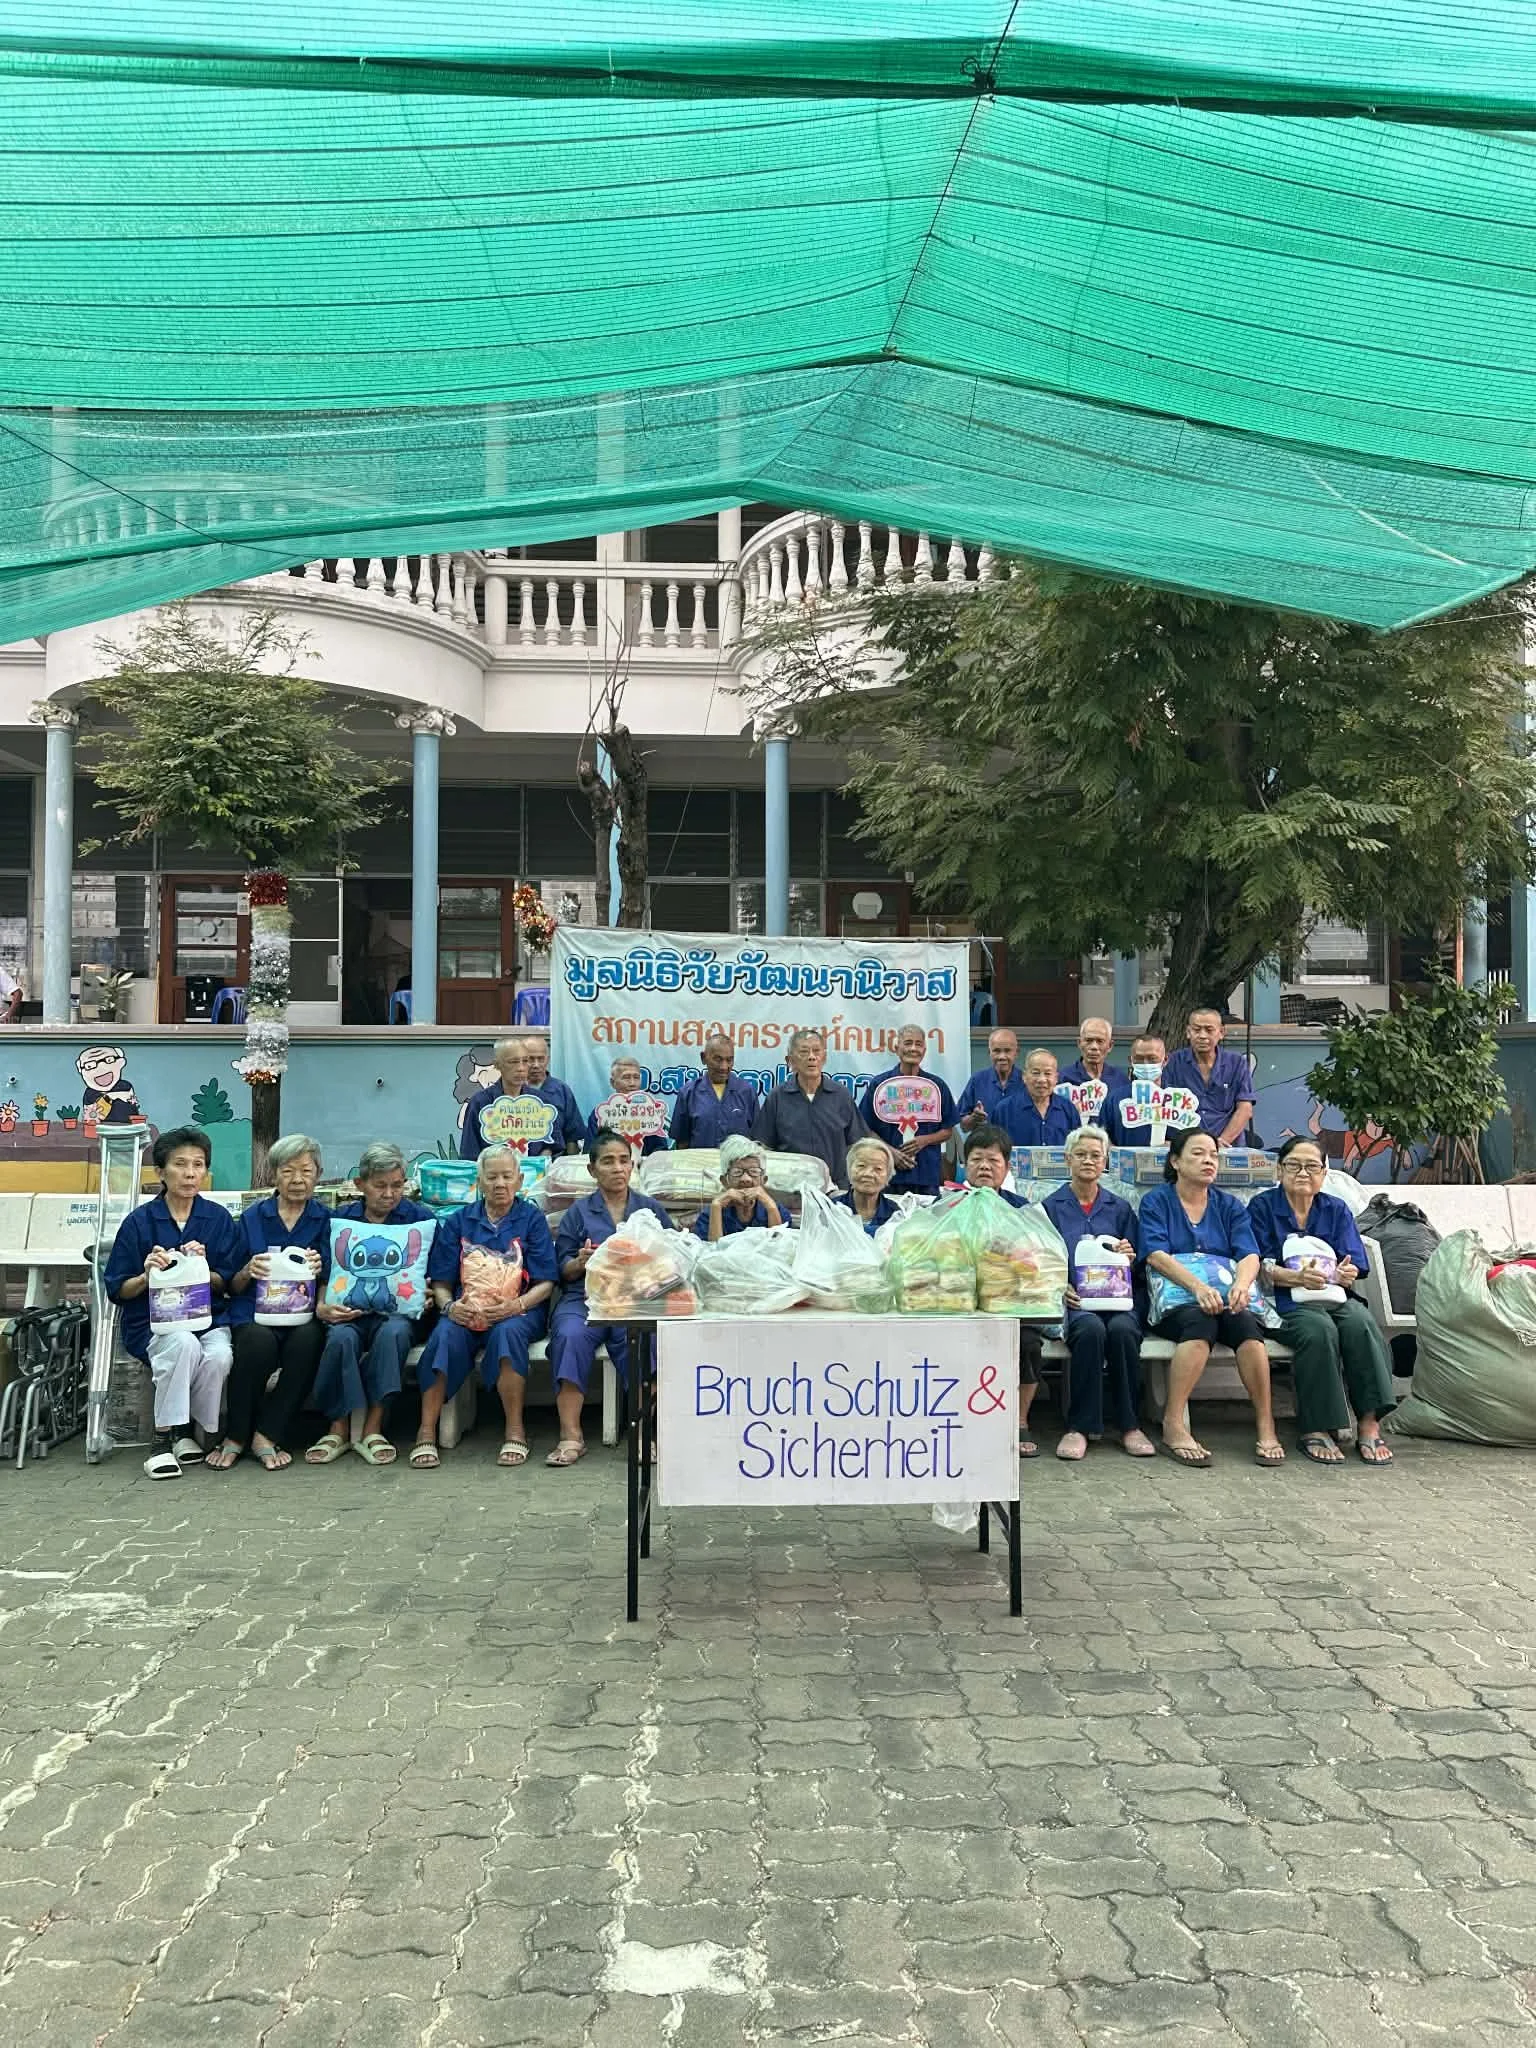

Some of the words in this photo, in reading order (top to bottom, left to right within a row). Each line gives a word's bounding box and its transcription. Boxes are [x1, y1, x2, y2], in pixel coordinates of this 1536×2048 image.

[566, 949, 957, 1001] มูลนิธิวัยวัฒนานิวาส
[1126, 1104, 1196, 1126] BIRTHDAY
[1136, 1084, 1192, 1110] HAPPY
[696, 1361, 813, 1417] Bruch
[823, 1357, 960, 1417] Schutz
[967, 1365, 1007, 1415] &
[738, 1418, 964, 1479] Sicherheit
